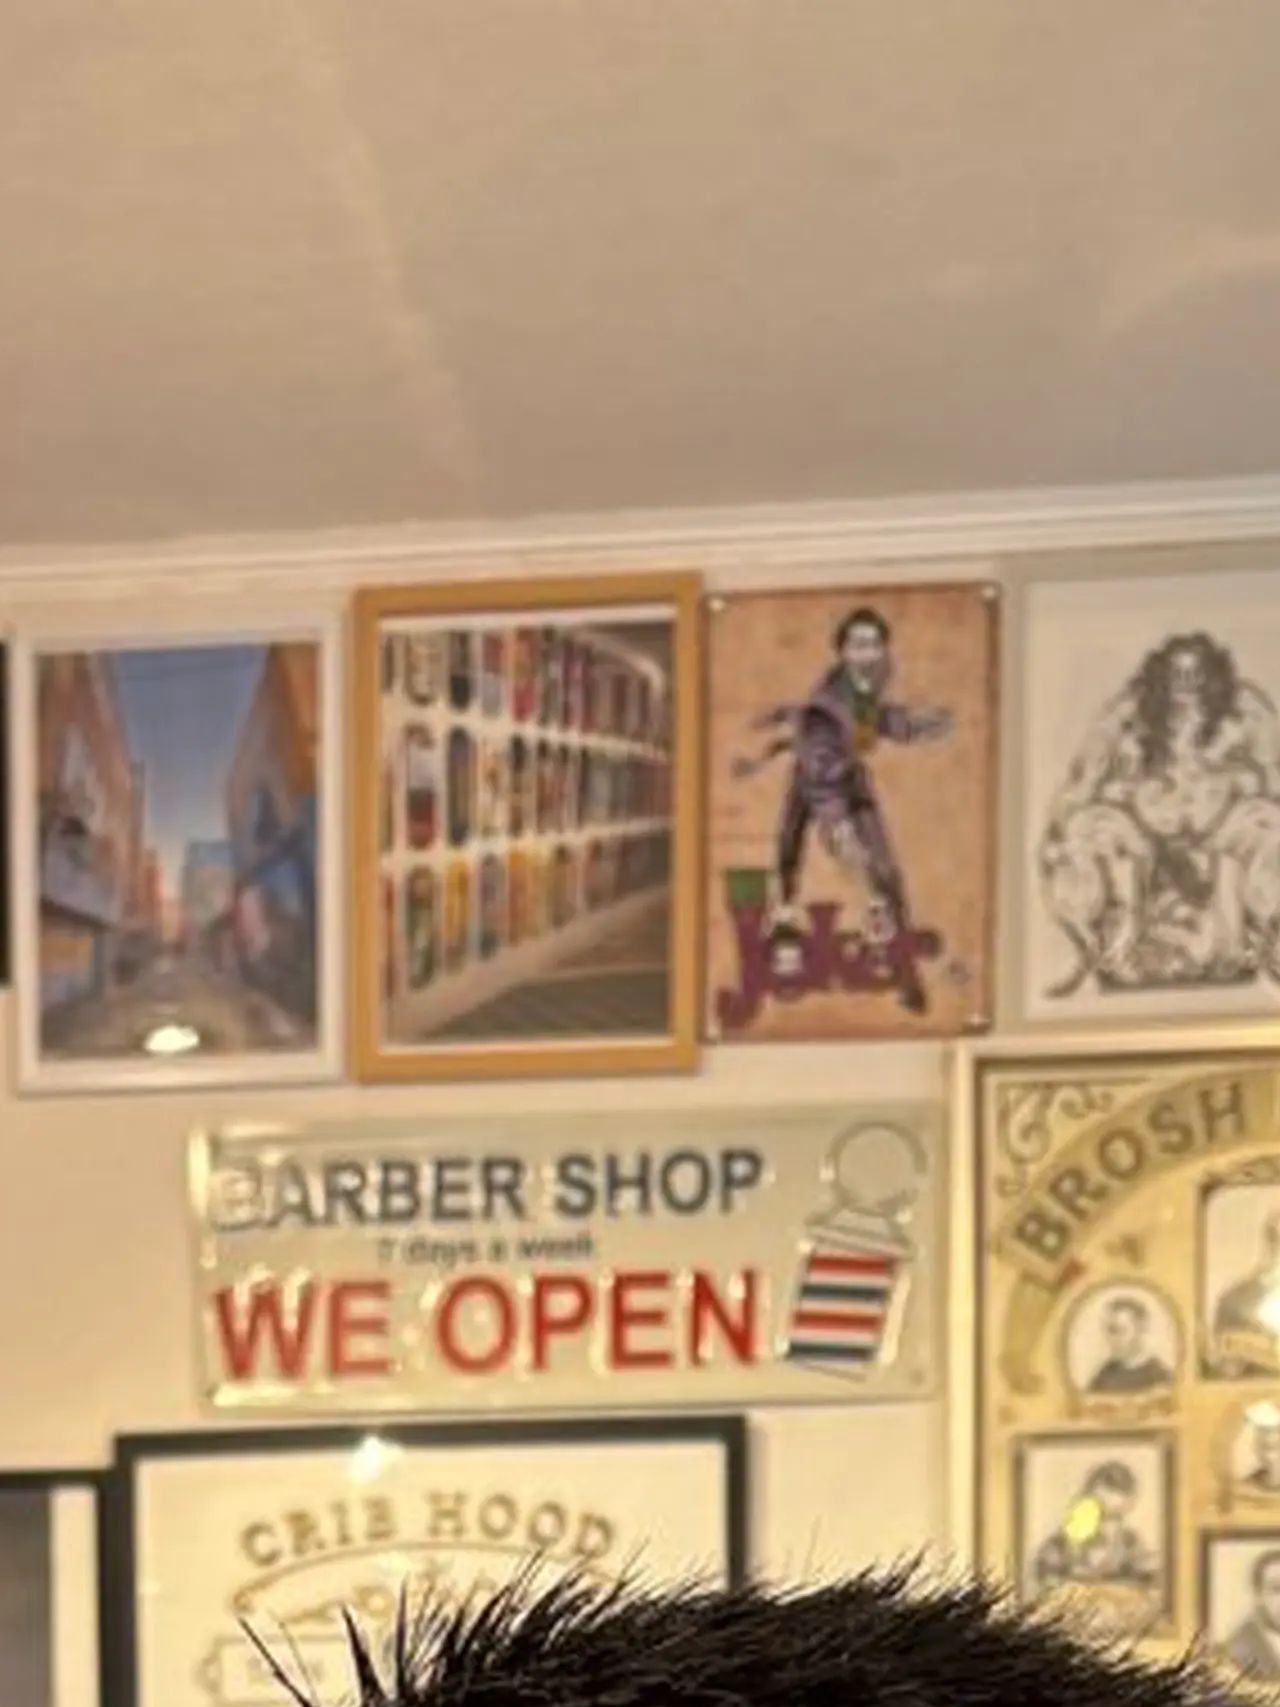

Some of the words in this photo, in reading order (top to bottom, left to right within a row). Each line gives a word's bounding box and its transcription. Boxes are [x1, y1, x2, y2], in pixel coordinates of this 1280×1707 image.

[208, 1152, 529, 1233] BARBER
[554, 1146, 763, 1218] SHOP
[1016, 1080, 1248, 1260] BROSH
[404, 1236, 478, 1268] days
[516, 1234, 595, 1260] week
[214, 1280, 391, 1379] WE
[434, 1268, 757, 1375] OPEN
[426, 1493, 614, 1560] HOOD
